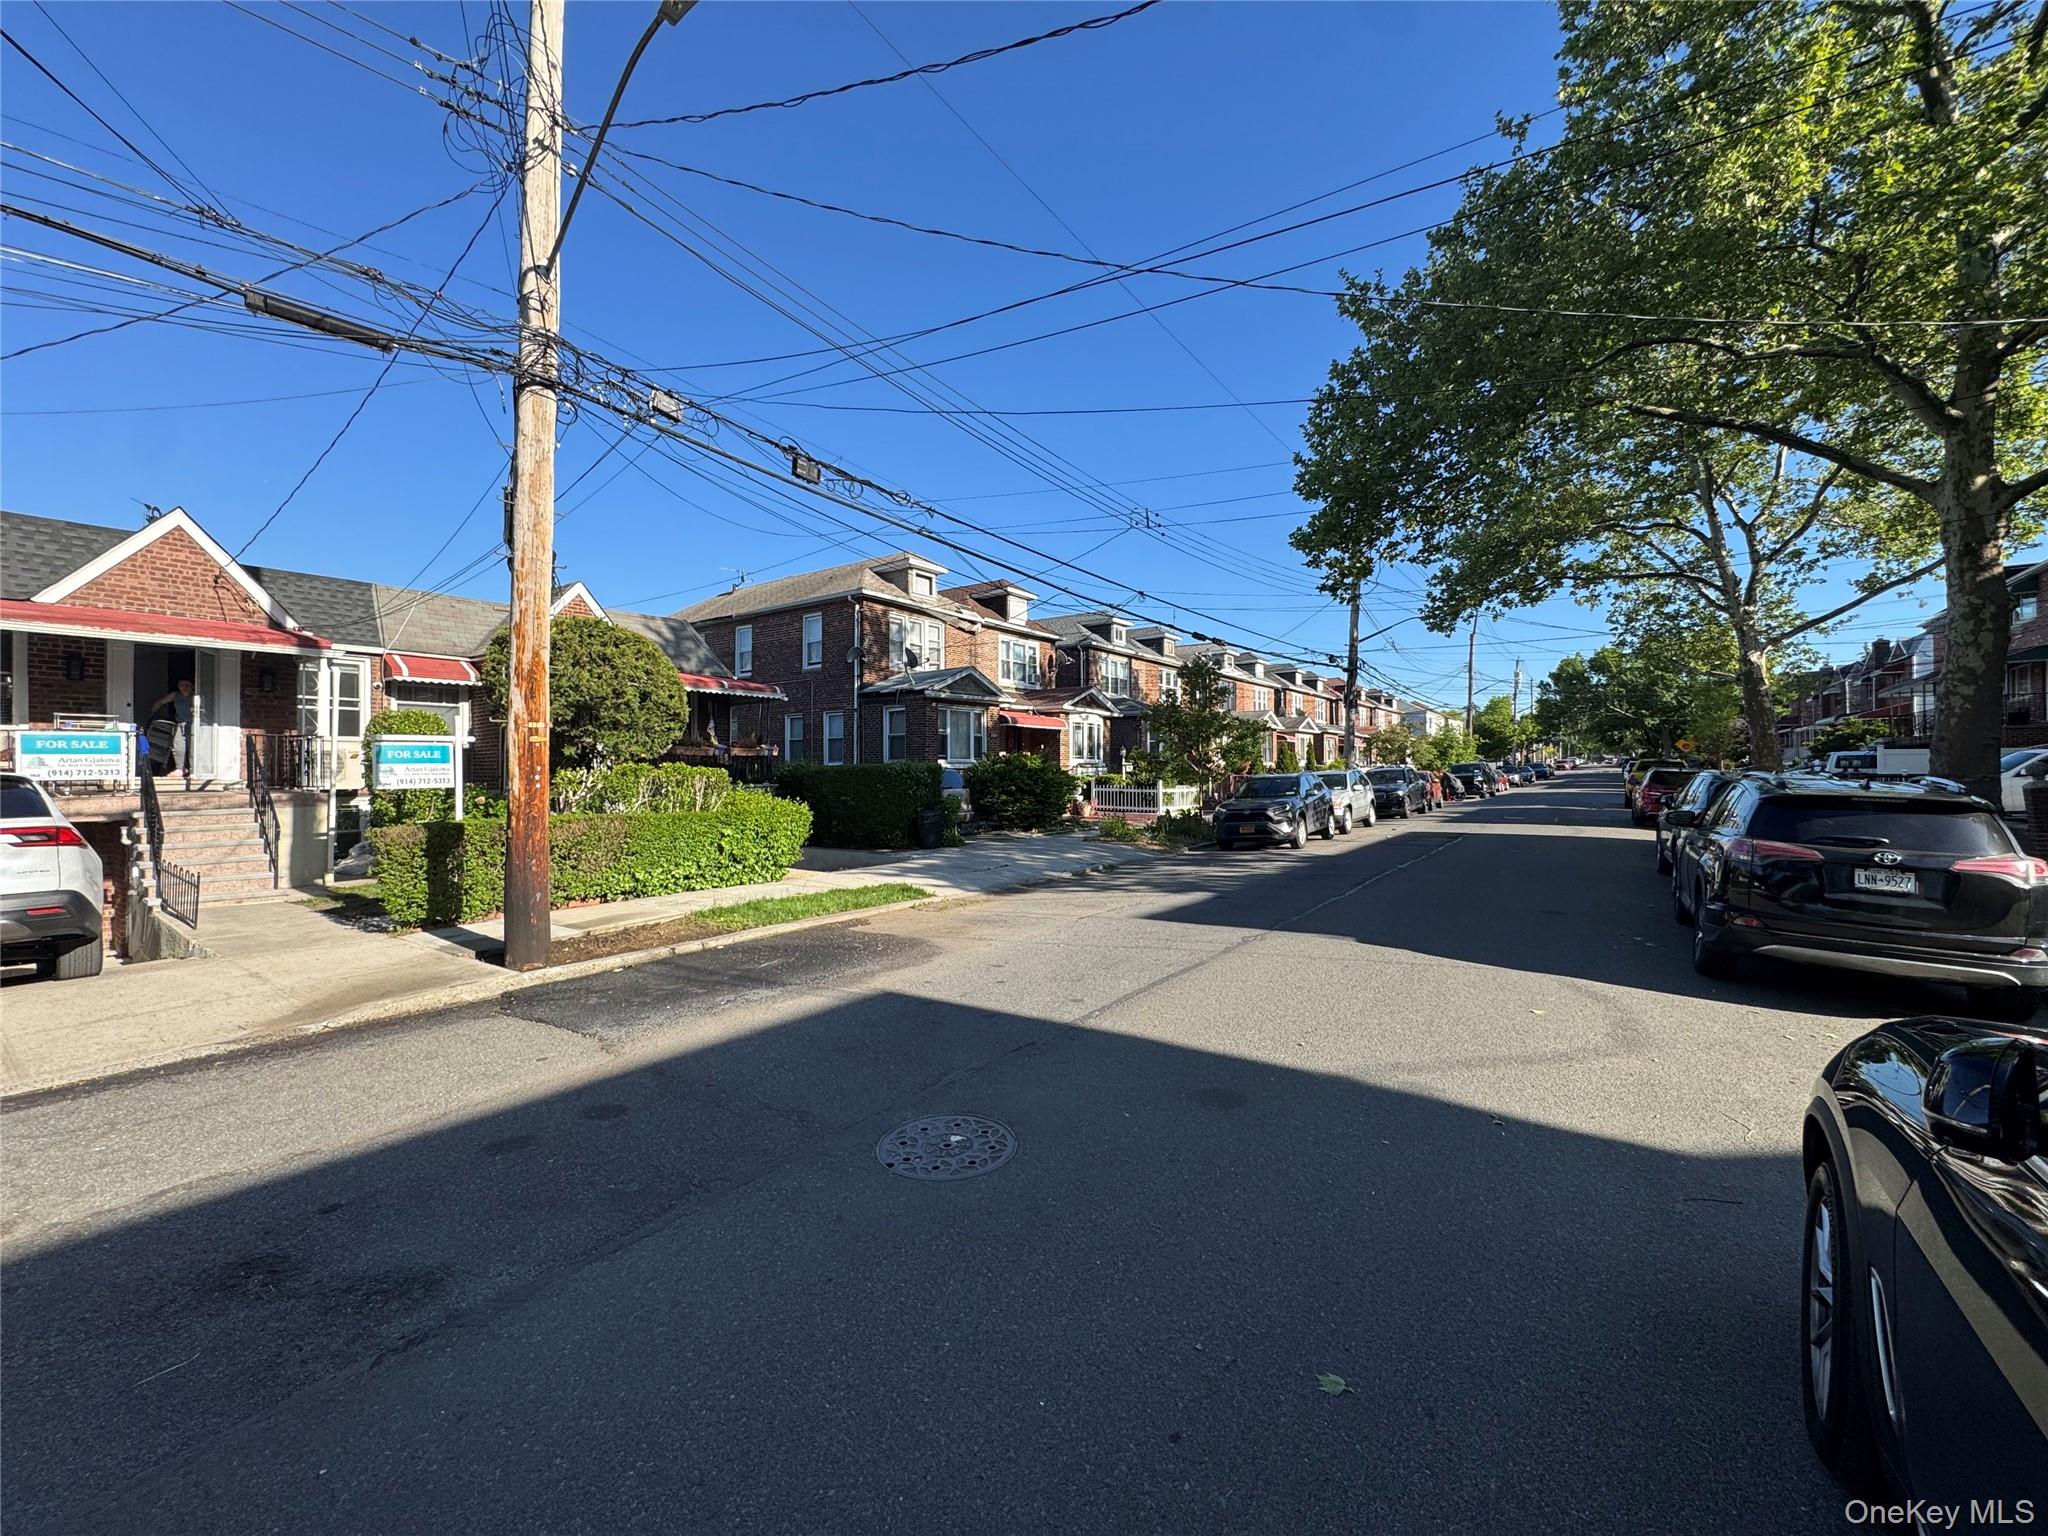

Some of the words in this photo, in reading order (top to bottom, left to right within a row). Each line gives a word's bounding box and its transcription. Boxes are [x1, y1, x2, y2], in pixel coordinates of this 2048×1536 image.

[35, 740, 67, 749] FOR
[71, 740, 108, 749] SALE
[387, 750, 411, 759] FOR
[413, 750, 441, 759] SALE
[47, 769, 73, 777] (914)
[396, 778, 416, 786] (914)
